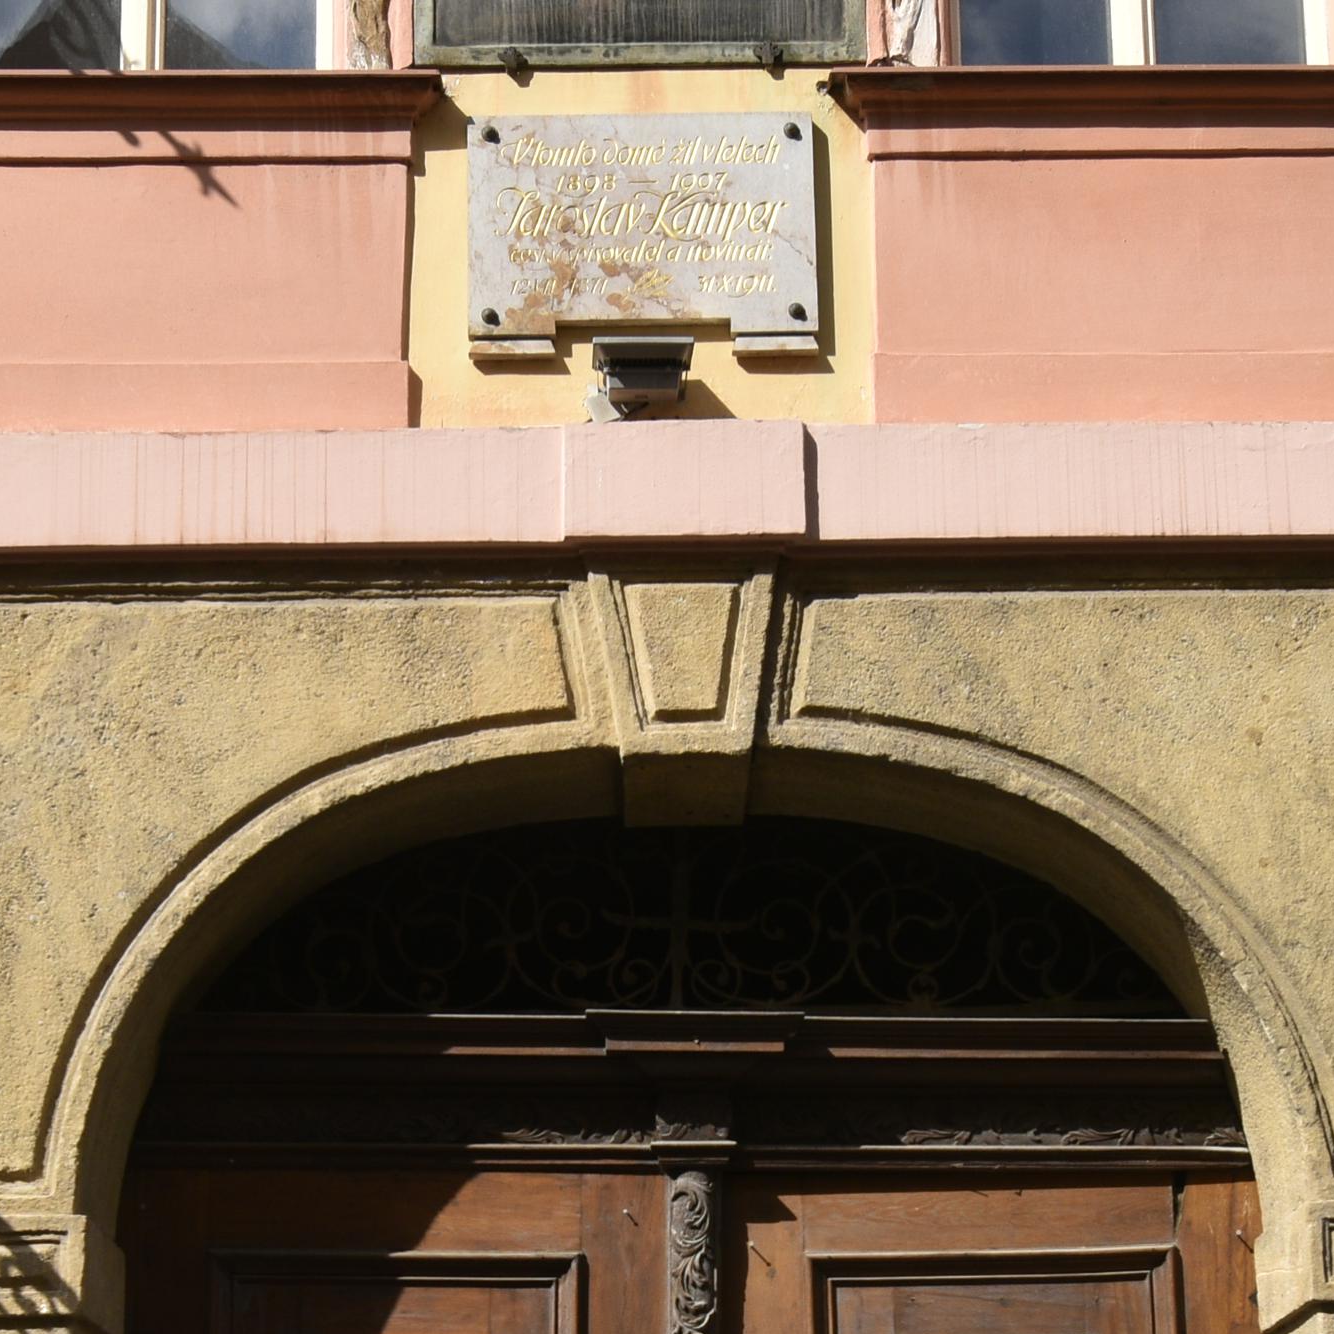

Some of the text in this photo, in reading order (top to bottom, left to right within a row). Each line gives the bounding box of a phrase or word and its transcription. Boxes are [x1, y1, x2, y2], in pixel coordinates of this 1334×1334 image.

[557, 173, 616, 198] 1898
[670, 171, 728, 193] 1907
[495, 187, 789, 241] Jaroslav Kamper
[667, 245, 682, 262] a
